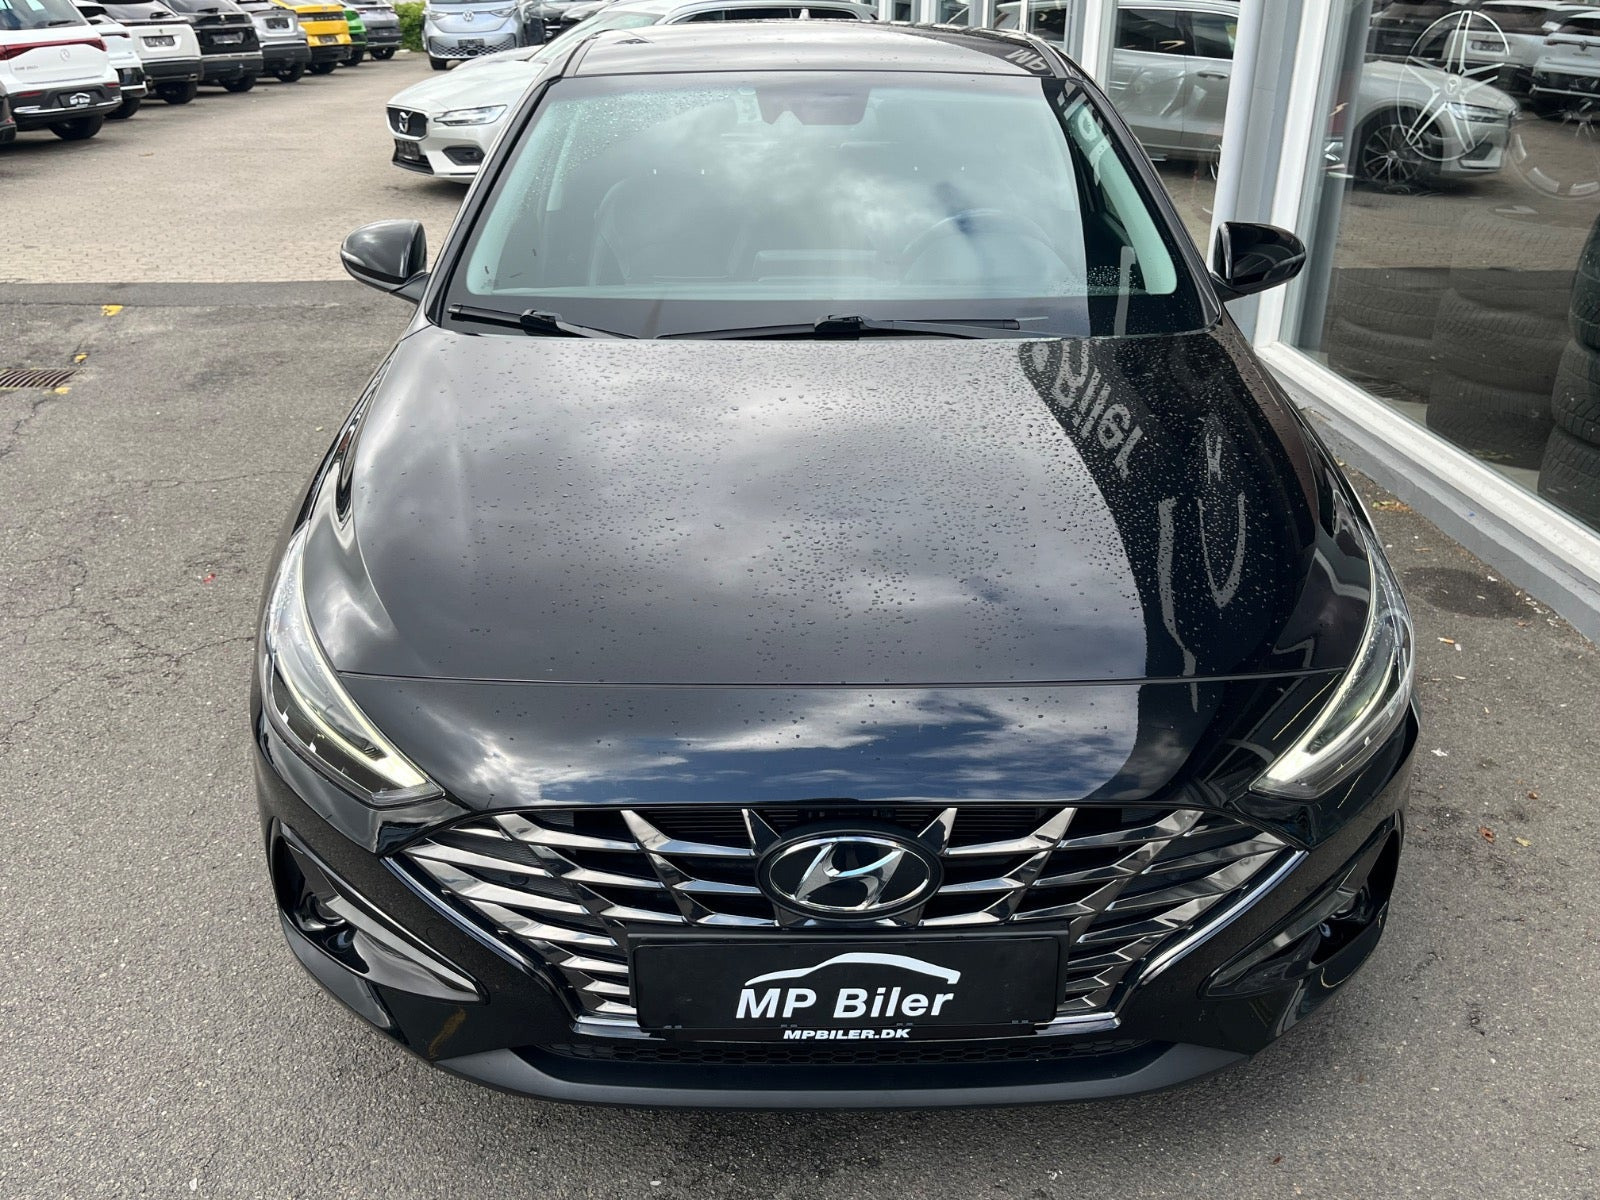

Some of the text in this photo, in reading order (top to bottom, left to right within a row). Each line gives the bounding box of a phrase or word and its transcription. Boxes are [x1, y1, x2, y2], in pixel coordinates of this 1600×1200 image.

[735, 986, 954, 1019] MP Biler
[783, 1028, 911, 1040] MPBILER.DK
